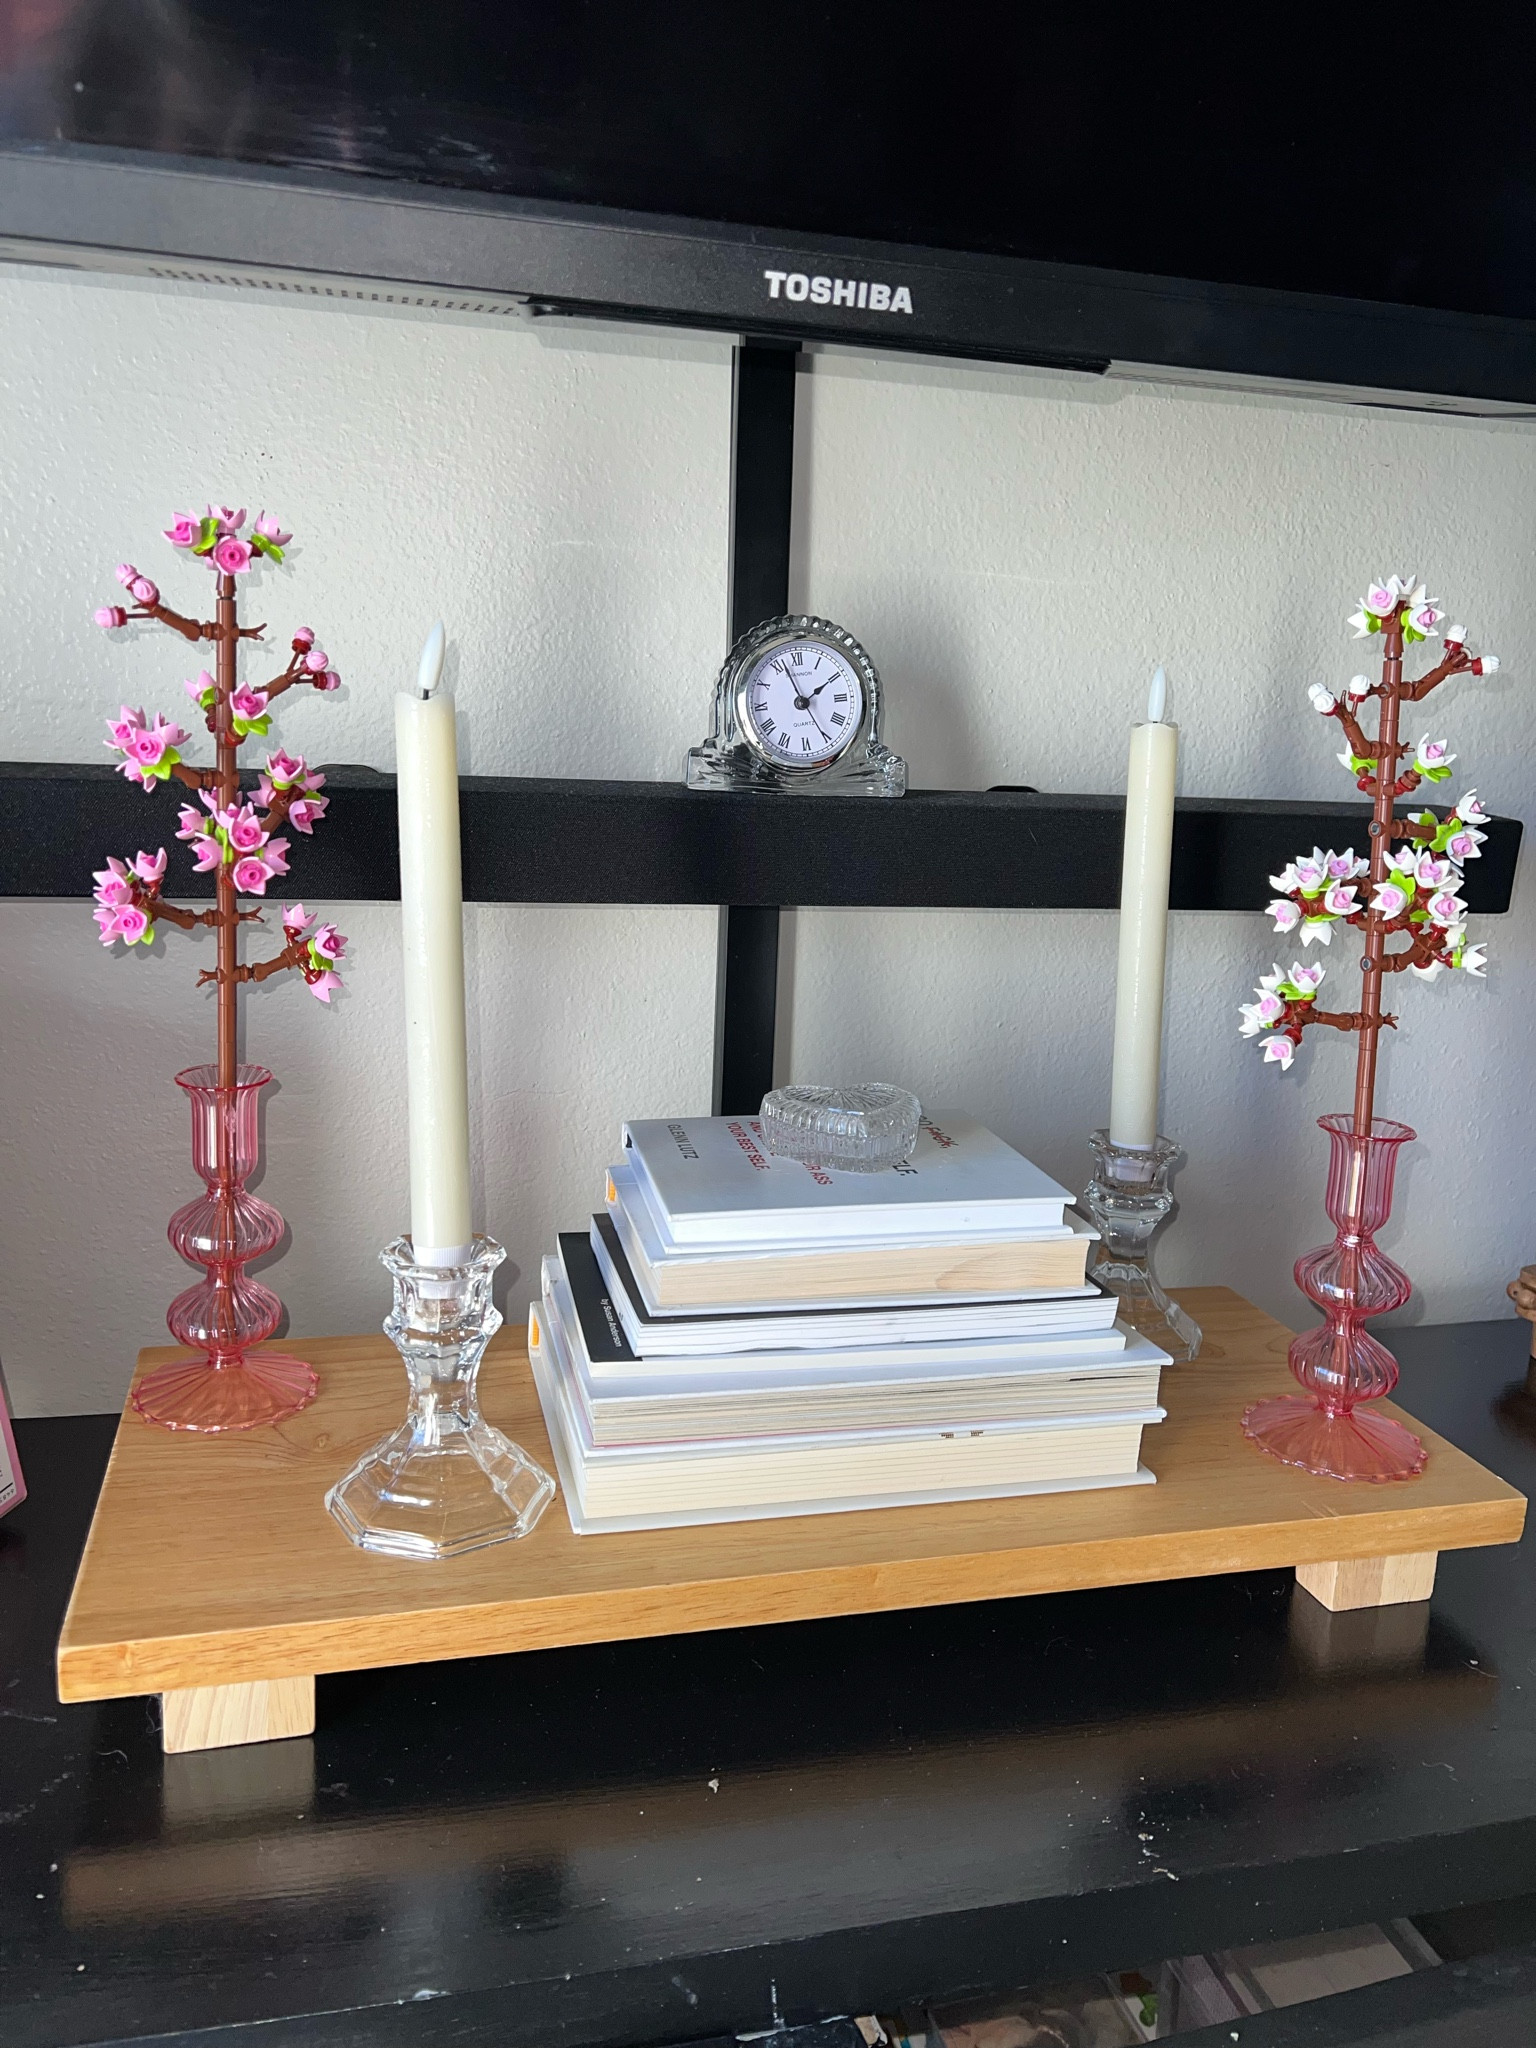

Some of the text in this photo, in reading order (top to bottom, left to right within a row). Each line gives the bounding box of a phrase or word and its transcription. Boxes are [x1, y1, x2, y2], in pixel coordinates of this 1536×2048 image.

[764, 270, 914, 315] TOSHIBA
[770, 659, 784, 675] XI
[791, 652, 803, 666] XII
[757, 679, 770, 690] X
[834, 693, 847, 703] III
[754, 702, 768, 712] IX
[778, 732, 790, 748] VII
[801, 737, 811, 751] VI
[726, 1121, 747, 1139] YOUR
[667, 1124, 699, 1159] GLENN LUTZ
[736, 1137, 759, 1155] BEST
[748, 1153, 770, 1170] SELF.
[812, 1171, 834, 1186] ASS
[604, 1306, 613, 1321] Susan
[609, 1322, 621, 1347] Anderson
